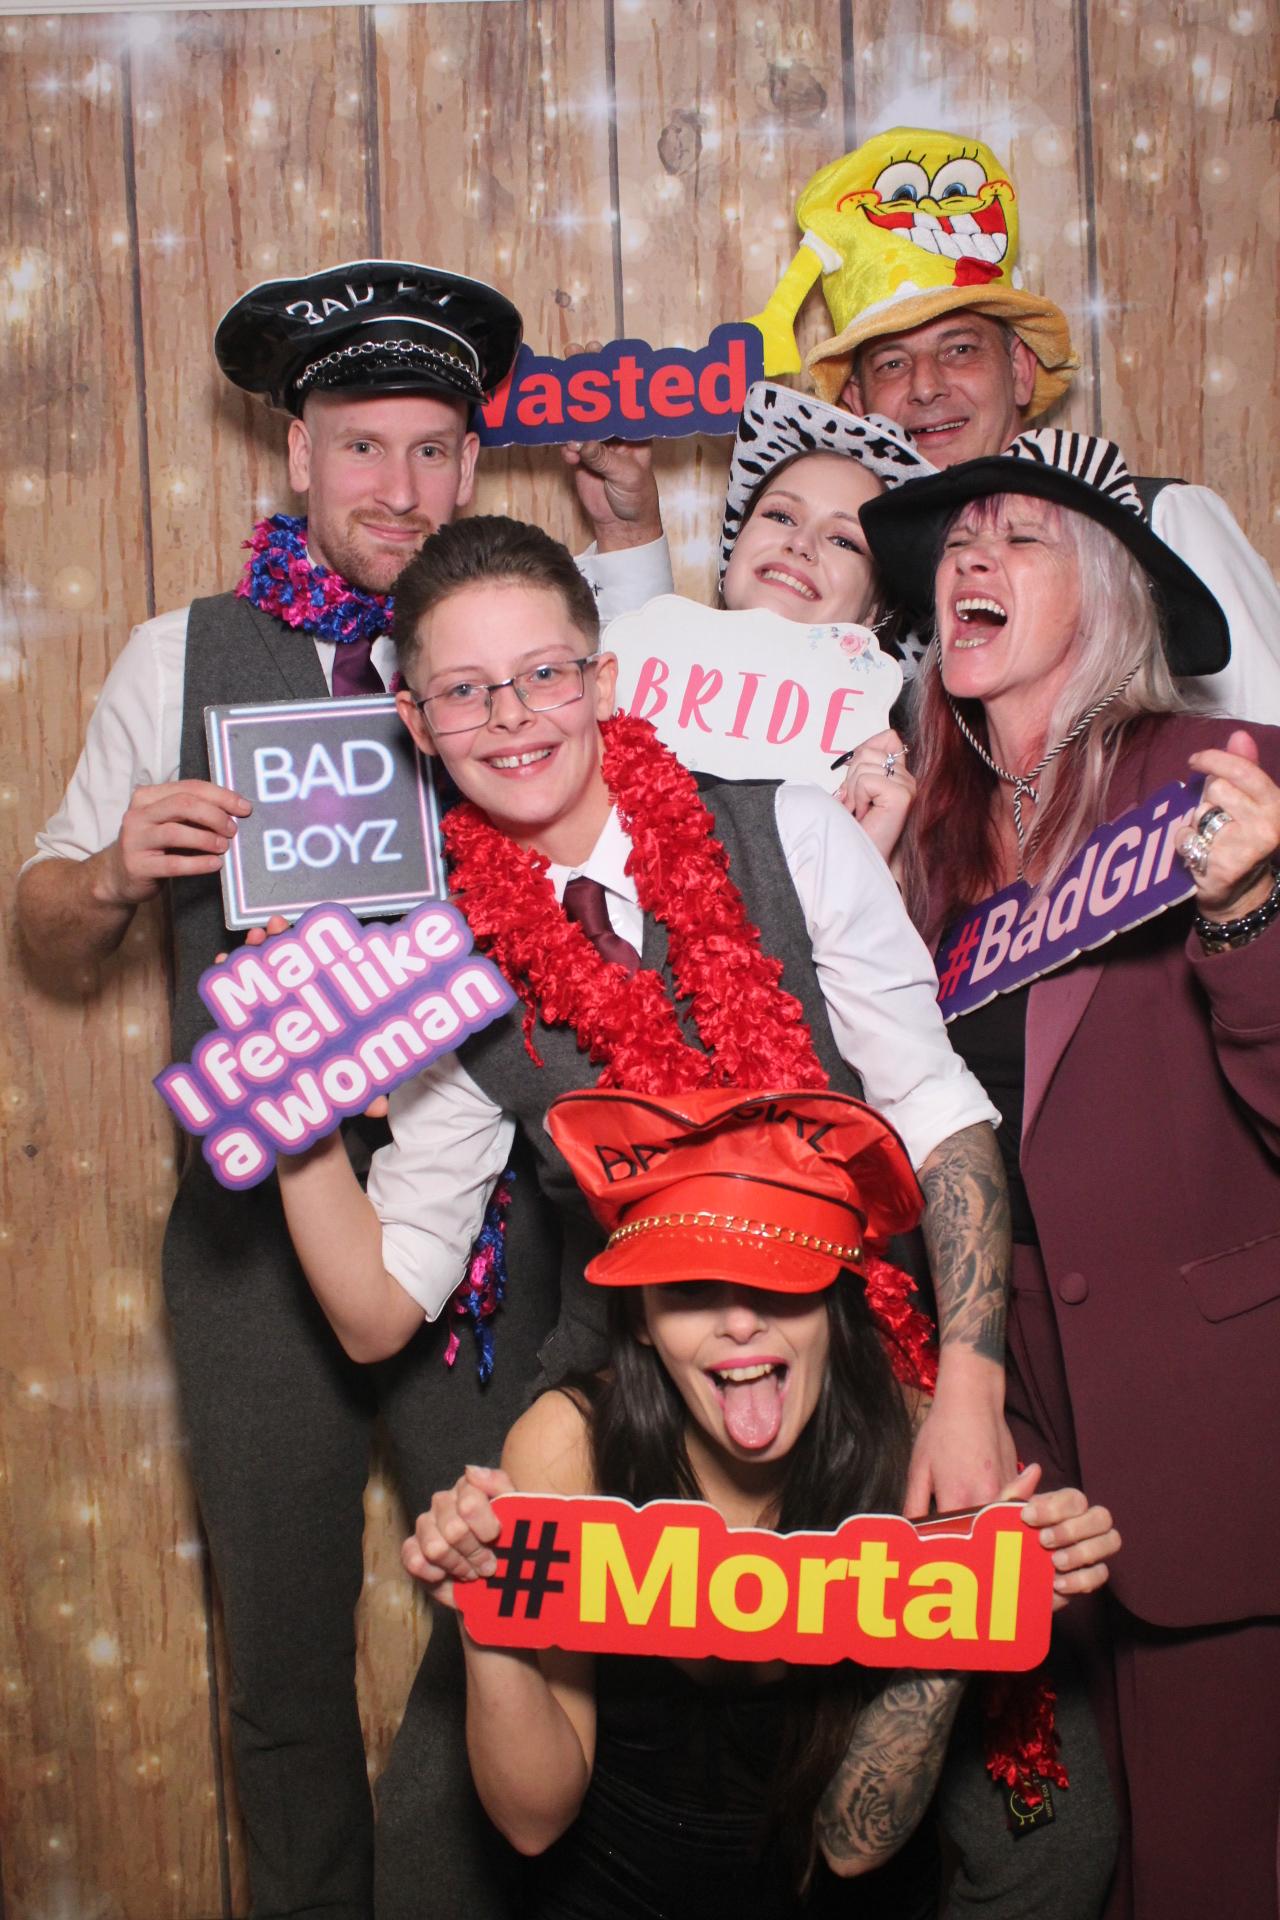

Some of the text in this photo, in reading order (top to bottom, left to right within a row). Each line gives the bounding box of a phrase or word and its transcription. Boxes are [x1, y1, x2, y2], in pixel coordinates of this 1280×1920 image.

[630, 657, 864, 755] BRIDE
[254, 740, 395, 803] BAD
[263, 819, 402, 872] BOYZ
[937, 799, 1197, 1001] #BadGir
[170, 914, 460, 1123] I feel like
[211, 916, 354, 1026] Man
[216, 1131, 262, 1177] a
[594, 1139, 684, 1184] BA
[486, 1519, 1023, 1642] #Mortal
